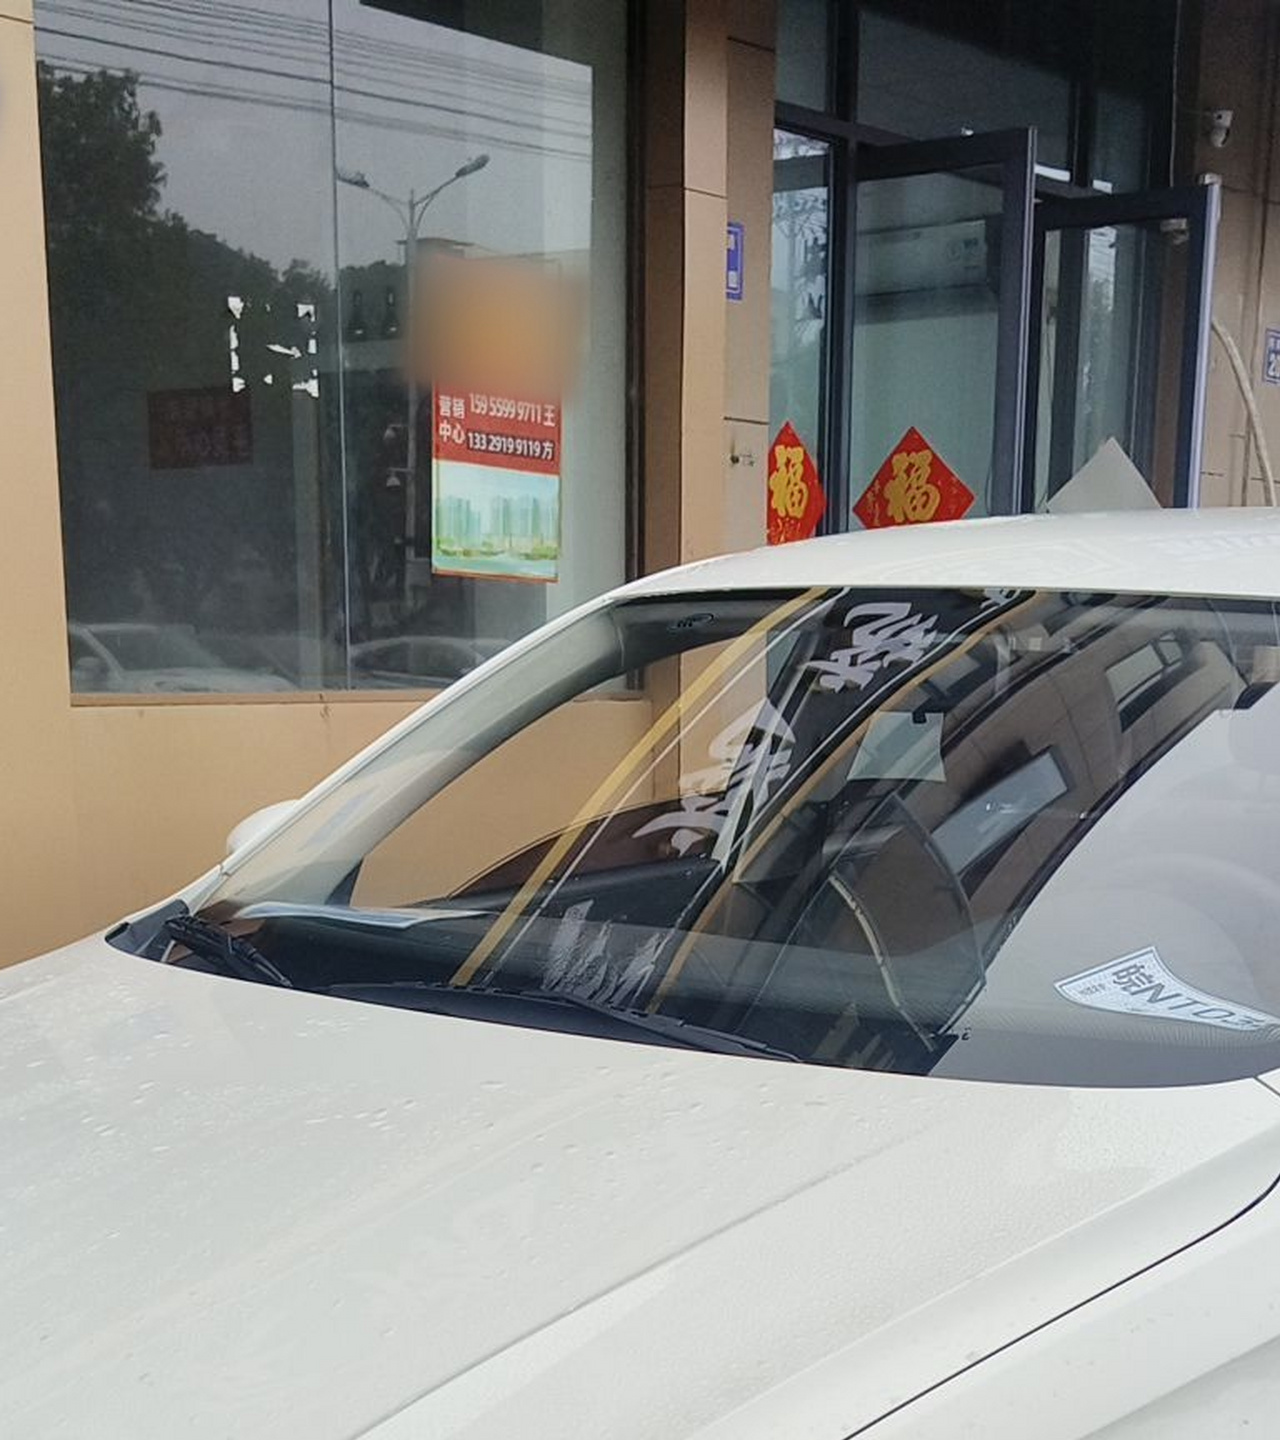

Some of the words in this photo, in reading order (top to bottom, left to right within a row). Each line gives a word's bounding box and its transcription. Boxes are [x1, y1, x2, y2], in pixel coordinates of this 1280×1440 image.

[439, 395, 465, 419] 营销
[469, 393, 488, 415] 159
[489, 397, 516, 419] 5599
[516, 400, 542, 424] 9711
[543, 404, 556, 427] 王
[439, 420, 466, 444] 中心
[468, 432, 487, 450] 133
[488, 435, 514, 454] 2919
[515, 438, 541, 457] 9119
[542, 442, 554, 460] 方
[769, 444, 809, 519] 福
[883, 448, 941, 523] 福
